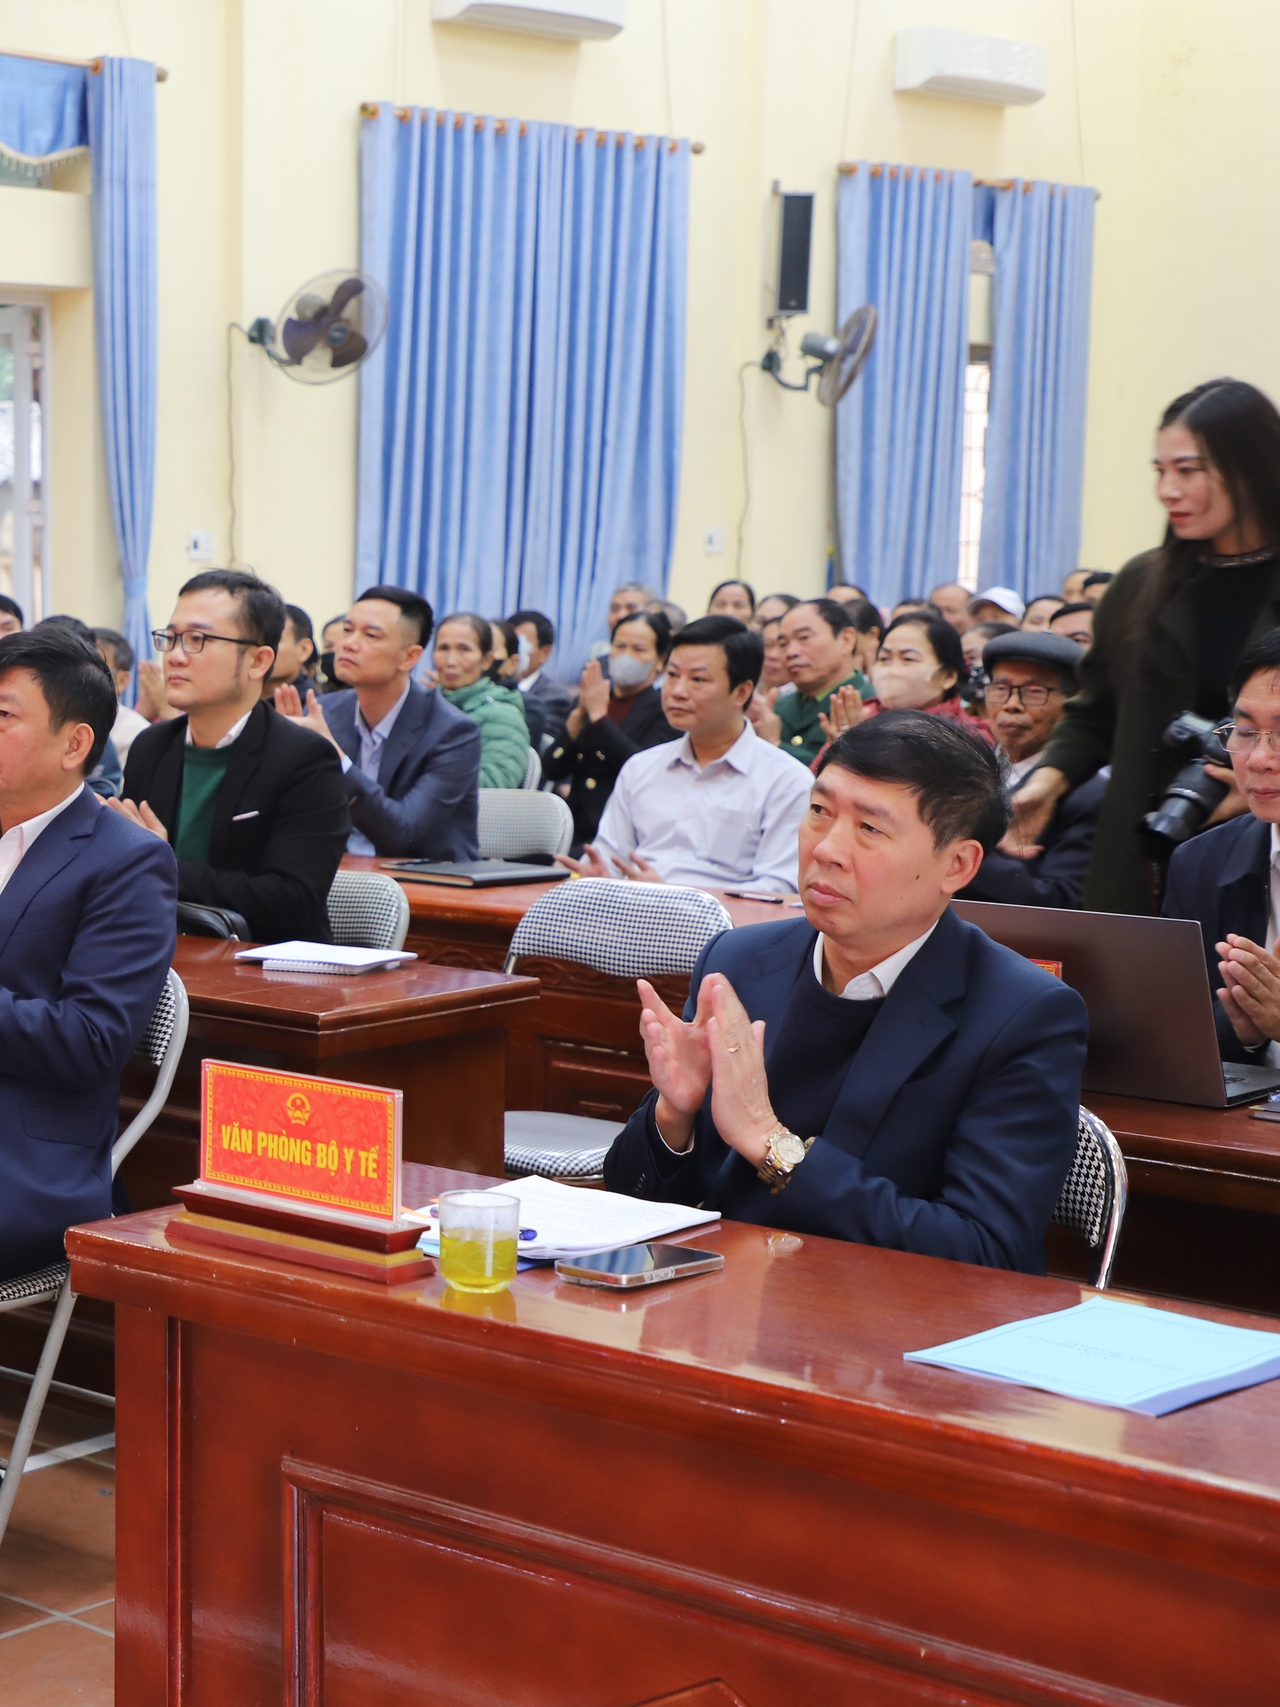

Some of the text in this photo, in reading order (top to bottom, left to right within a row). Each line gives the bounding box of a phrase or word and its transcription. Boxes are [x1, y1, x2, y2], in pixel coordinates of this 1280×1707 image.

[221, 1122, 380, 1179] VĂN PHÒNG BỘ Y TẾ
